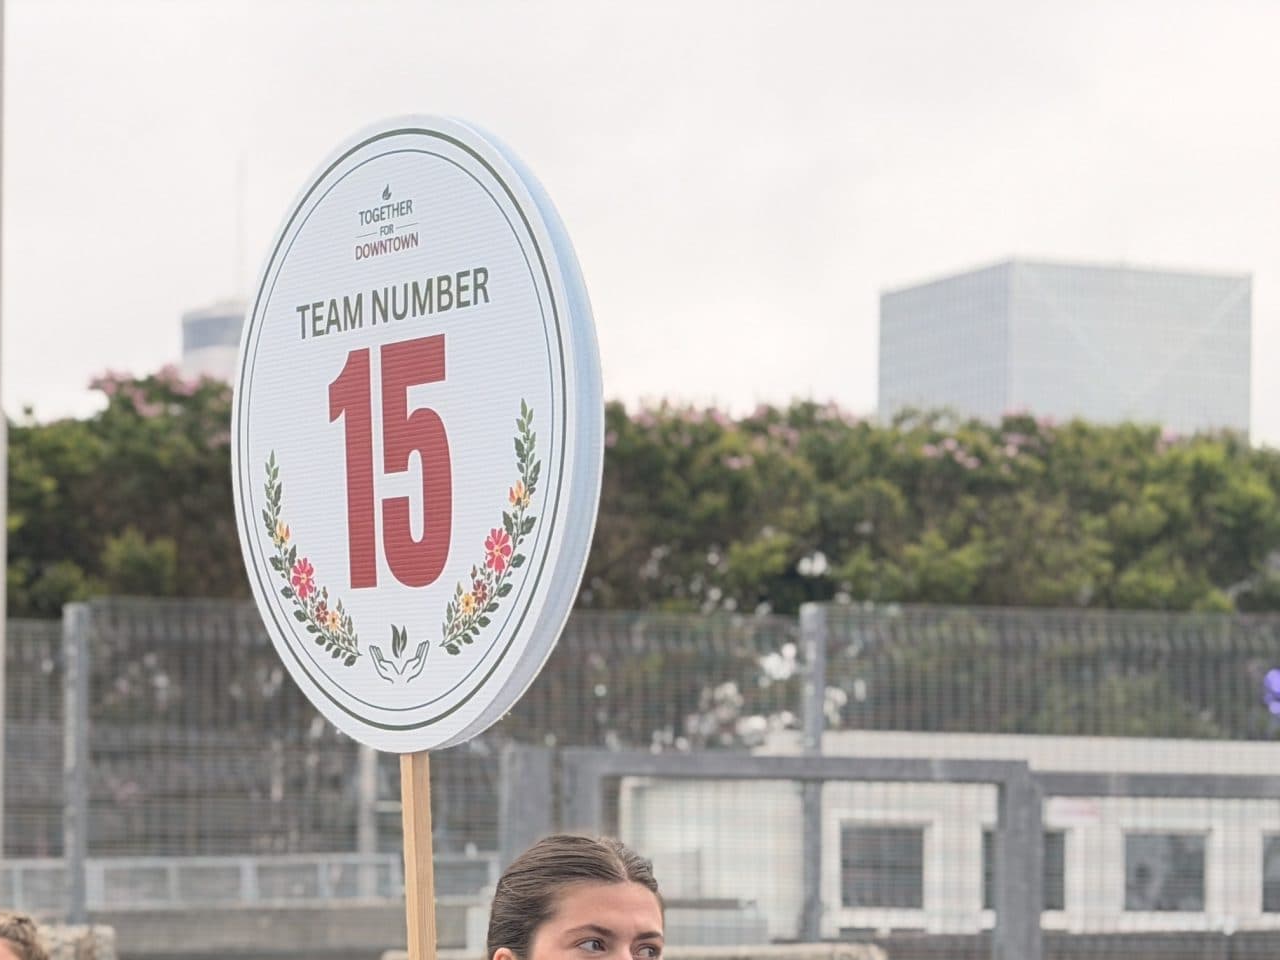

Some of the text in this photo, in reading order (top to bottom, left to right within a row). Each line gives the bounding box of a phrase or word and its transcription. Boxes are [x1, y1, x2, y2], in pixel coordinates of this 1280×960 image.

[358, 199, 414, 226] TOGETHER
[379, 223, 395, 237] FOR
[355, 231, 420, 261] DOWNTOWN
[296, 266, 490, 340] TEAM NUMBER
[328, 333, 453, 589] 15
